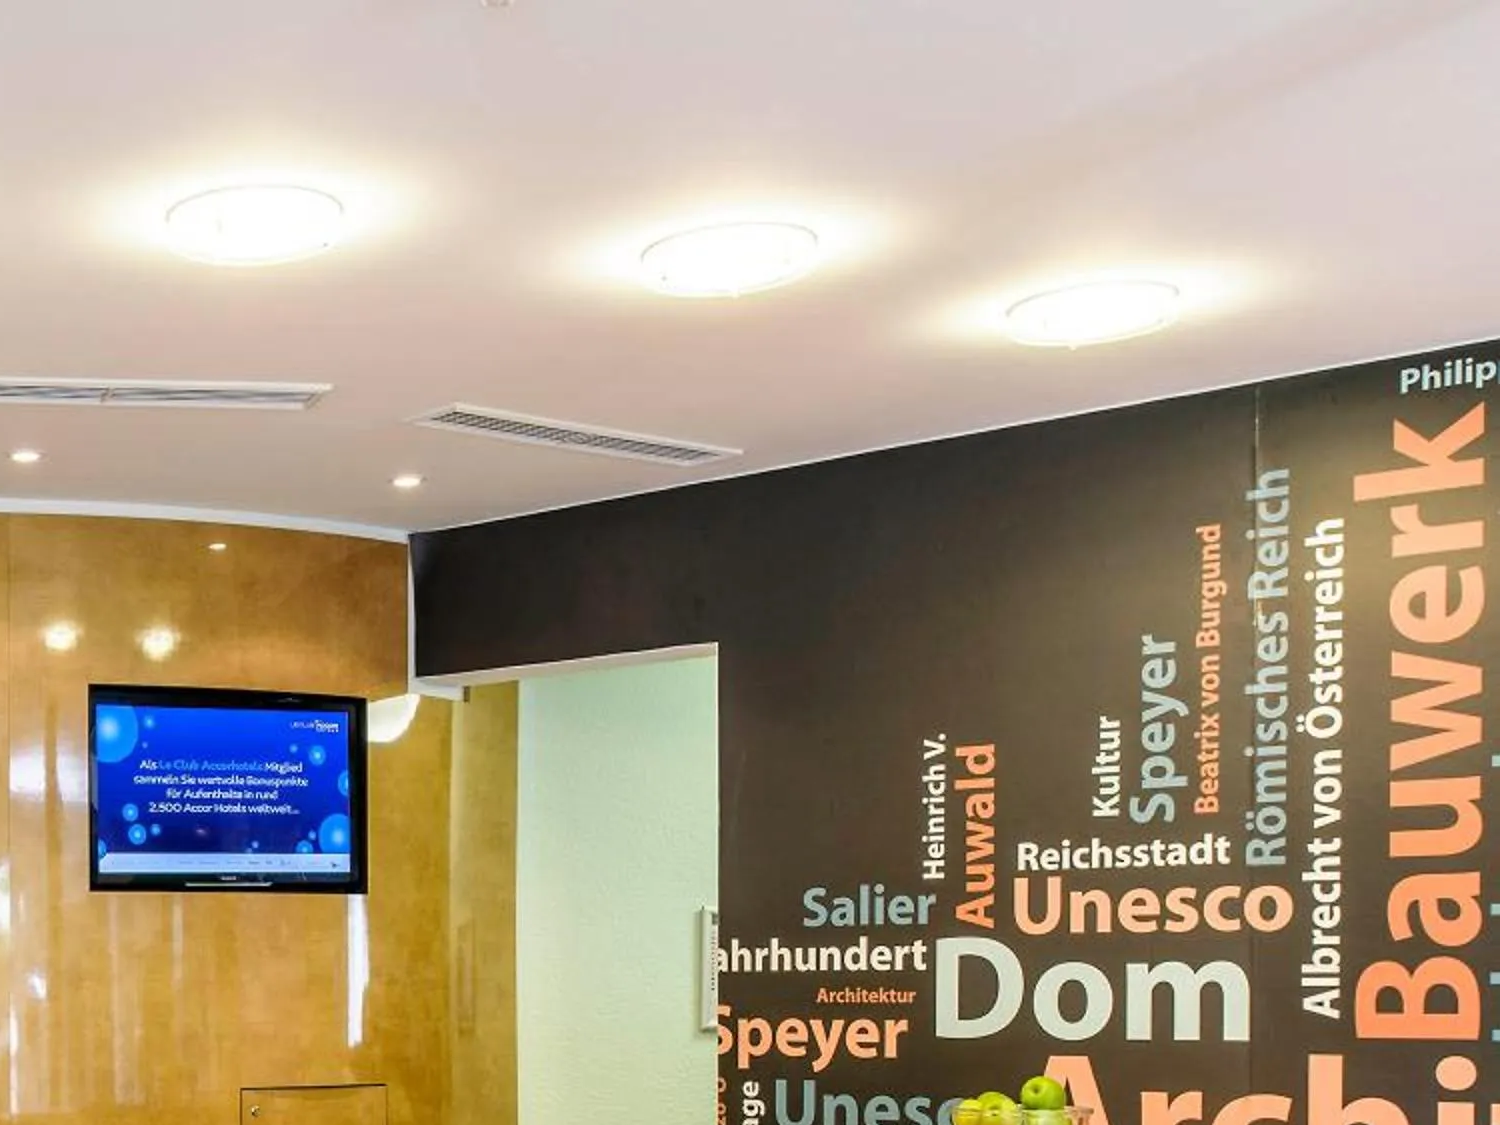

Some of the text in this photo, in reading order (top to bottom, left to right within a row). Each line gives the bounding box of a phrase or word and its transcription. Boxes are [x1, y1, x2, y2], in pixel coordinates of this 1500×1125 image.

[1401, 357, 1500, 394] Philip
[1193, 523, 1228, 814] Beatrix von Burgund
[1244, 468, 1290, 866] Römisches Reich
[1092, 715, 1121, 817] Kultur
[1129, 634, 1189, 824] Speyer
[1296, 517, 1345, 1019] Albrecht von Österreich
[1354, 402, 1486, 1040] Bauwerk
[922, 733, 947, 880] Heinrich V.
[955, 743, 996, 929] Auwald
[1017, 833, 1231, 871] Reichsstadt
[803, 884, 937, 928] Salier
[1013, 876, 1294, 935] Unesco
[718, 1003, 909, 1073] Speyer
[816, 987, 917, 1004] Architektur
[935, 936, 1251, 1042] Dom
